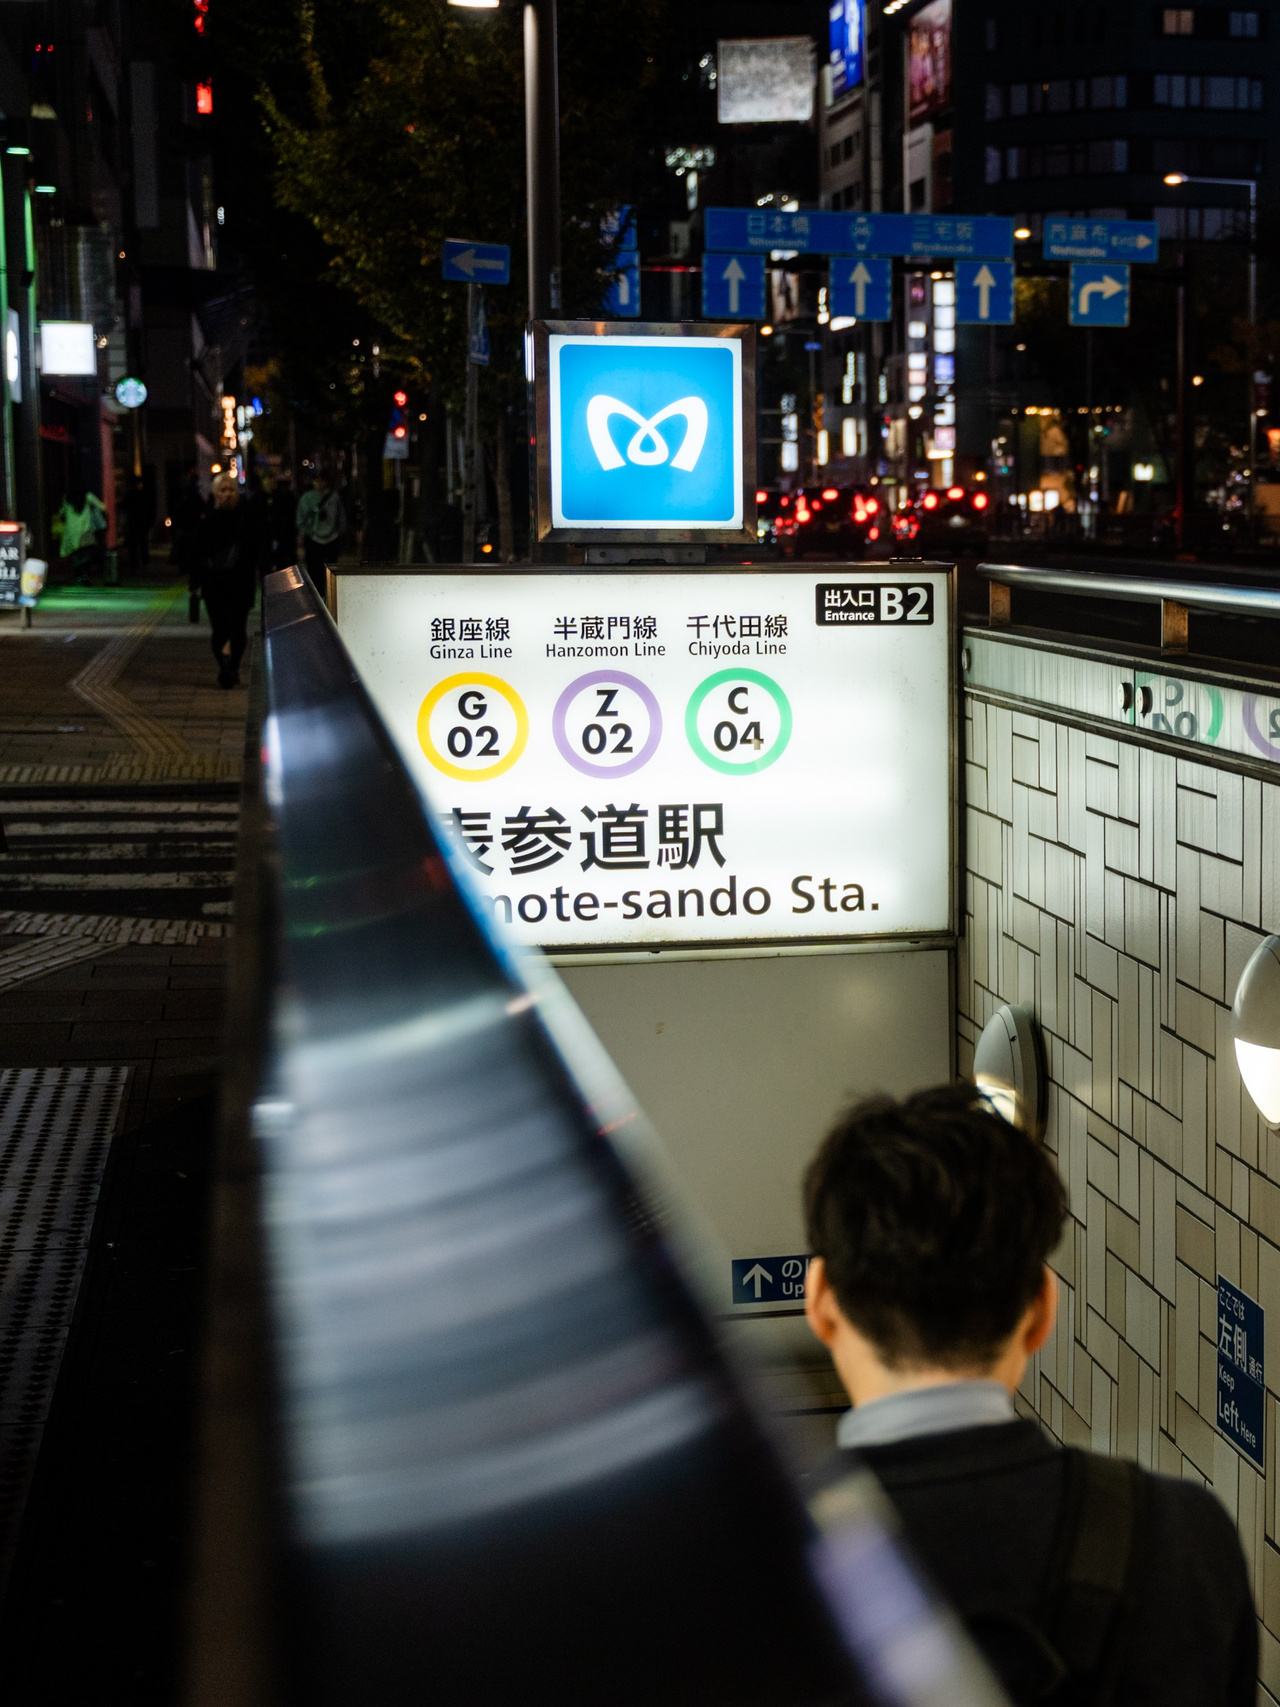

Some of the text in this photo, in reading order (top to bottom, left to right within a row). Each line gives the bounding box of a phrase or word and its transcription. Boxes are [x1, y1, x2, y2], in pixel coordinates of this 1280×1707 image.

[824, 589, 875, 607] 出入口
[880, 587, 929, 621] B2
[430, 617, 511, 642] 銀座線
[553, 615, 659, 641] 半蔵門線
[686, 614, 789, 639] 千代田線
[824, 610, 875, 621] Entrance
[430, 644, 513, 659] Ginza Line
[546, 642, 667, 658] Hanzomon Line
[688, 639, 787, 659] Chiyoda Line
[458, 690, 488, 720] G
[595, 689, 619, 717] Z
[727, 686, 749, 715] C
[447, 725, 500, 758] 02
[582, 723, 633, 755] 02
[713, 720, 764, 752] 04
[481, 875, 880, 924] mote-sando Sta.
[781, 1258, 810, 1279] の
[782, 1282, 804, 1297] Up
[1219, 1286, 1245, 1321] ここでは
[1218, 1363, 1235, 1393] Keep
[1218, 1391, 1257, 1448] Left Here
